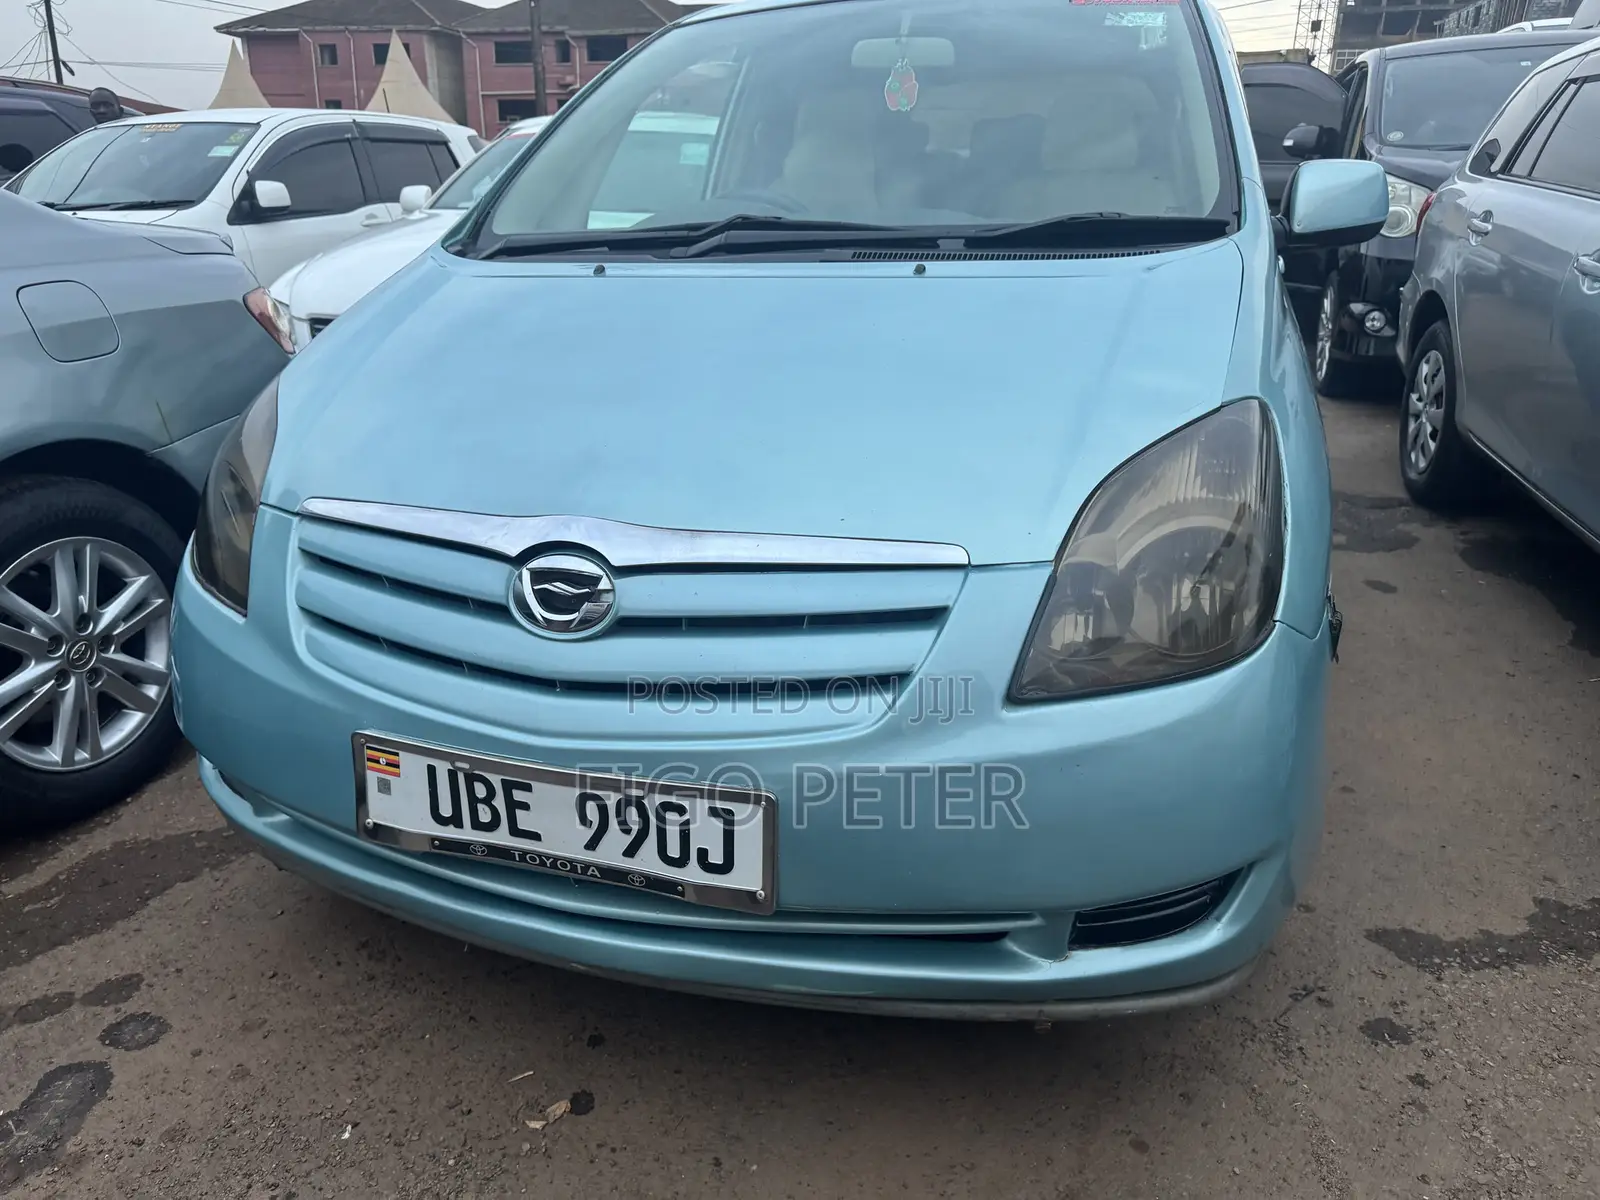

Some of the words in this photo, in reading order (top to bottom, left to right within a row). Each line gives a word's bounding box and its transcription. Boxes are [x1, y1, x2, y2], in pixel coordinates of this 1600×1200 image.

[427, 763, 542, 842] UBE
[575, 791, 735, 876] 990J
[510, 850, 601, 878] TOYOTA
